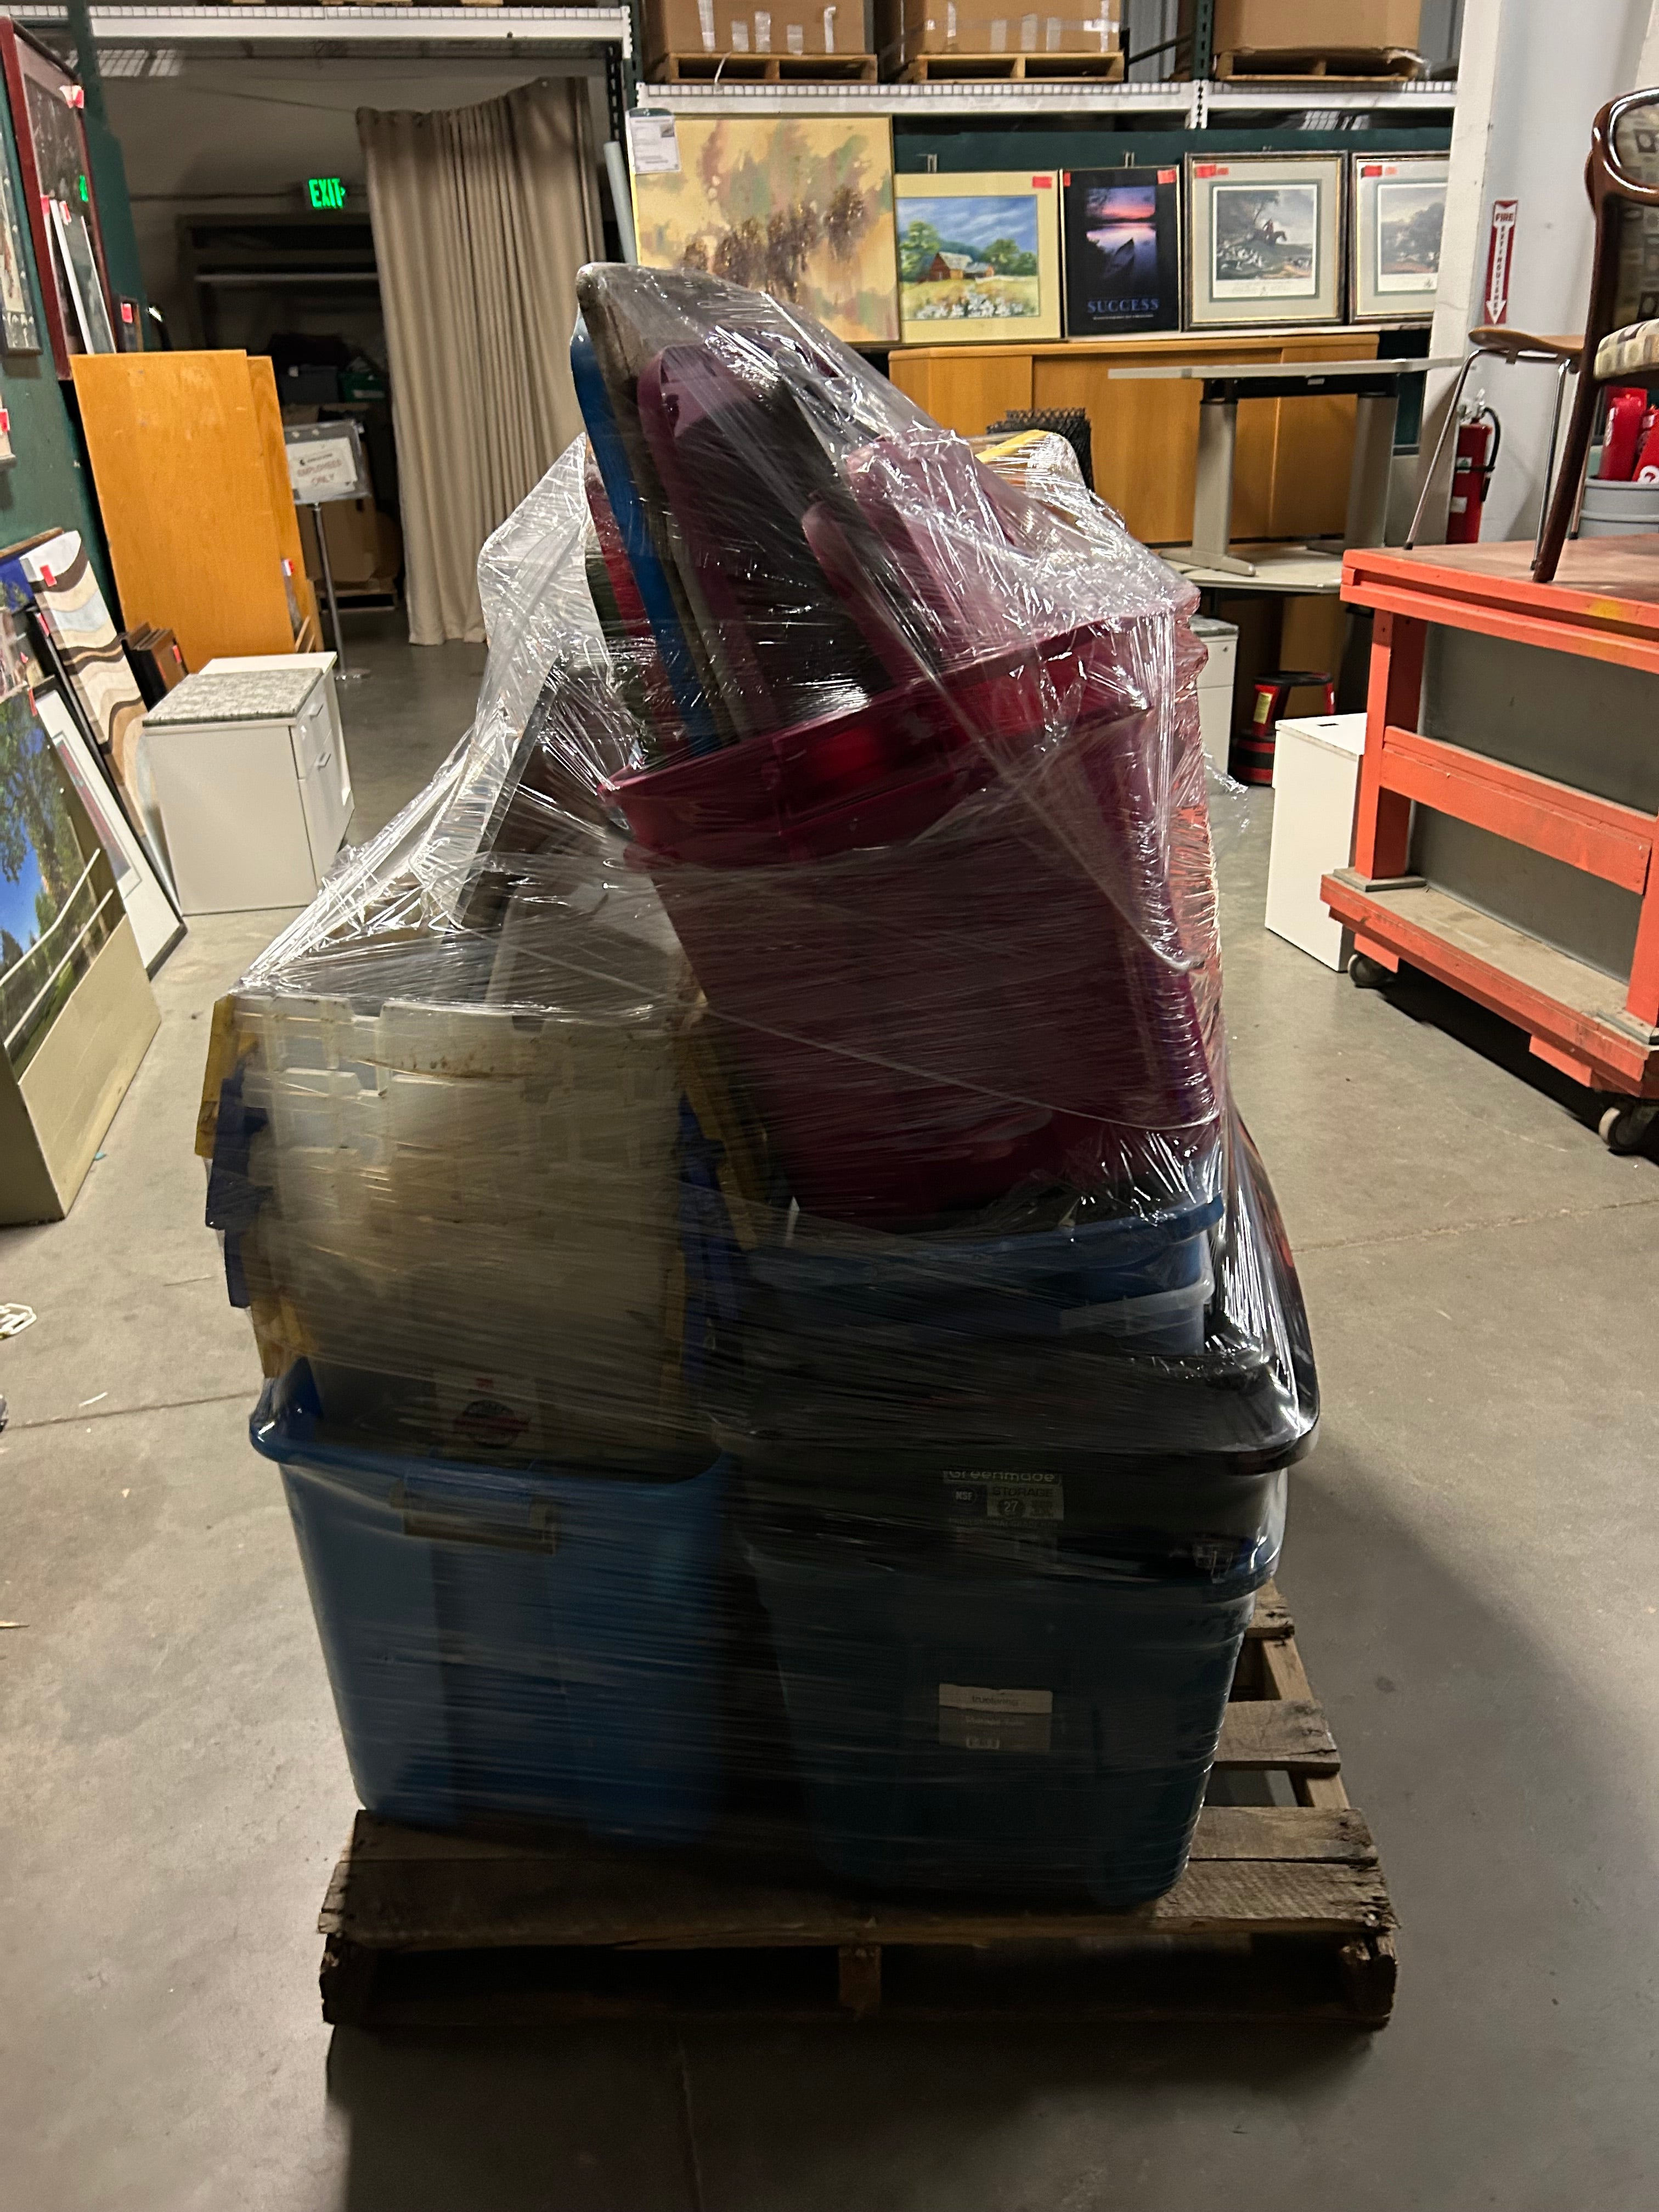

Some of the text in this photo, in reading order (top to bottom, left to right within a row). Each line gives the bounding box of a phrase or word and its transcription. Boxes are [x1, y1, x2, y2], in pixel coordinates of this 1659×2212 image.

[308, 178, 343, 208] EXIT
[1496, 213, 1514, 222] FIRE
[1493, 225, 1506, 316] EXTINGUISHER
[1087, 298, 1159, 313] SUCCESS
[955, 1491, 973, 1502] NSF
[992, 1487, 1054, 1497] STORAGE
[1003, 1501, 1019, 1513] 27
